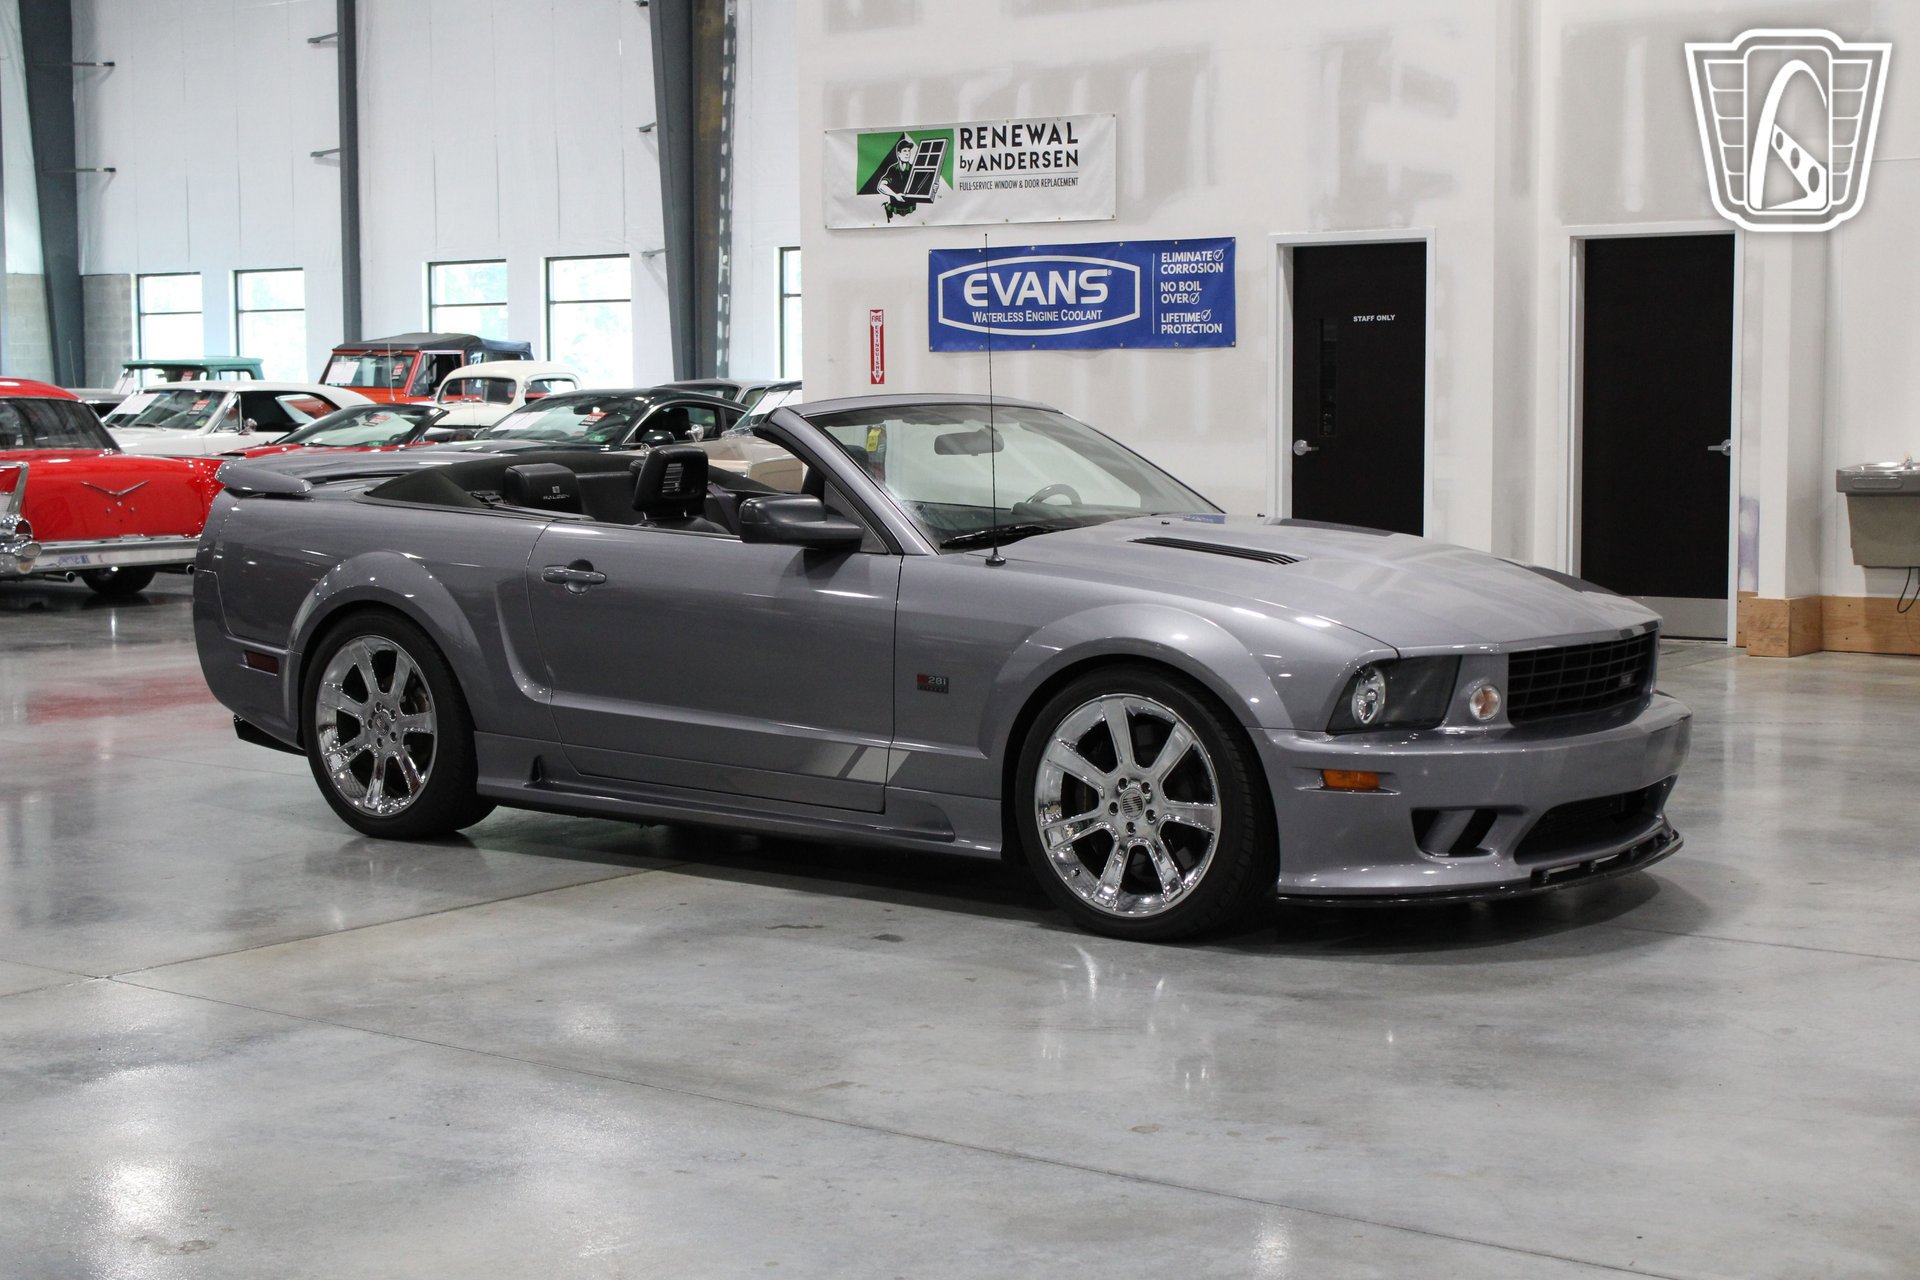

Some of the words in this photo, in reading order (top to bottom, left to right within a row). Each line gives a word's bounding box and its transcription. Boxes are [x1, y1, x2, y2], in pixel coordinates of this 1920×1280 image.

[960, 122, 1078, 150] RENEWAL
[960, 155, 973, 172] by
[976, 149, 1079, 171] ANDERSEN
[960, 181, 992, 191] FULL-SERVICE
[994, 180, 1018, 190] WINDOW
[1025, 179, 1040, 189] DOOR
[1041, 177, 1079, 188] REPLACEMENT
[1161, 250, 1213, 263] ELIMINATE
[1161, 262, 1224, 275] CORROSION
[1160, 281, 1176, 292] NO
[1179, 281, 1202, 292] BOIL
[1161, 293, 1189, 304] OVER
[972, 311, 1024, 323] WATERLESS
[1025, 309, 1059, 322] ENGINE
[1060, 308, 1103, 321] COOLANT
[1161, 312, 1201, 323] LIFETIME
[1353, 315, 1375, 323] STAFF
[1376, 314, 1396, 322] ONLY
[1161, 323, 1223, 335] PROTECTION
